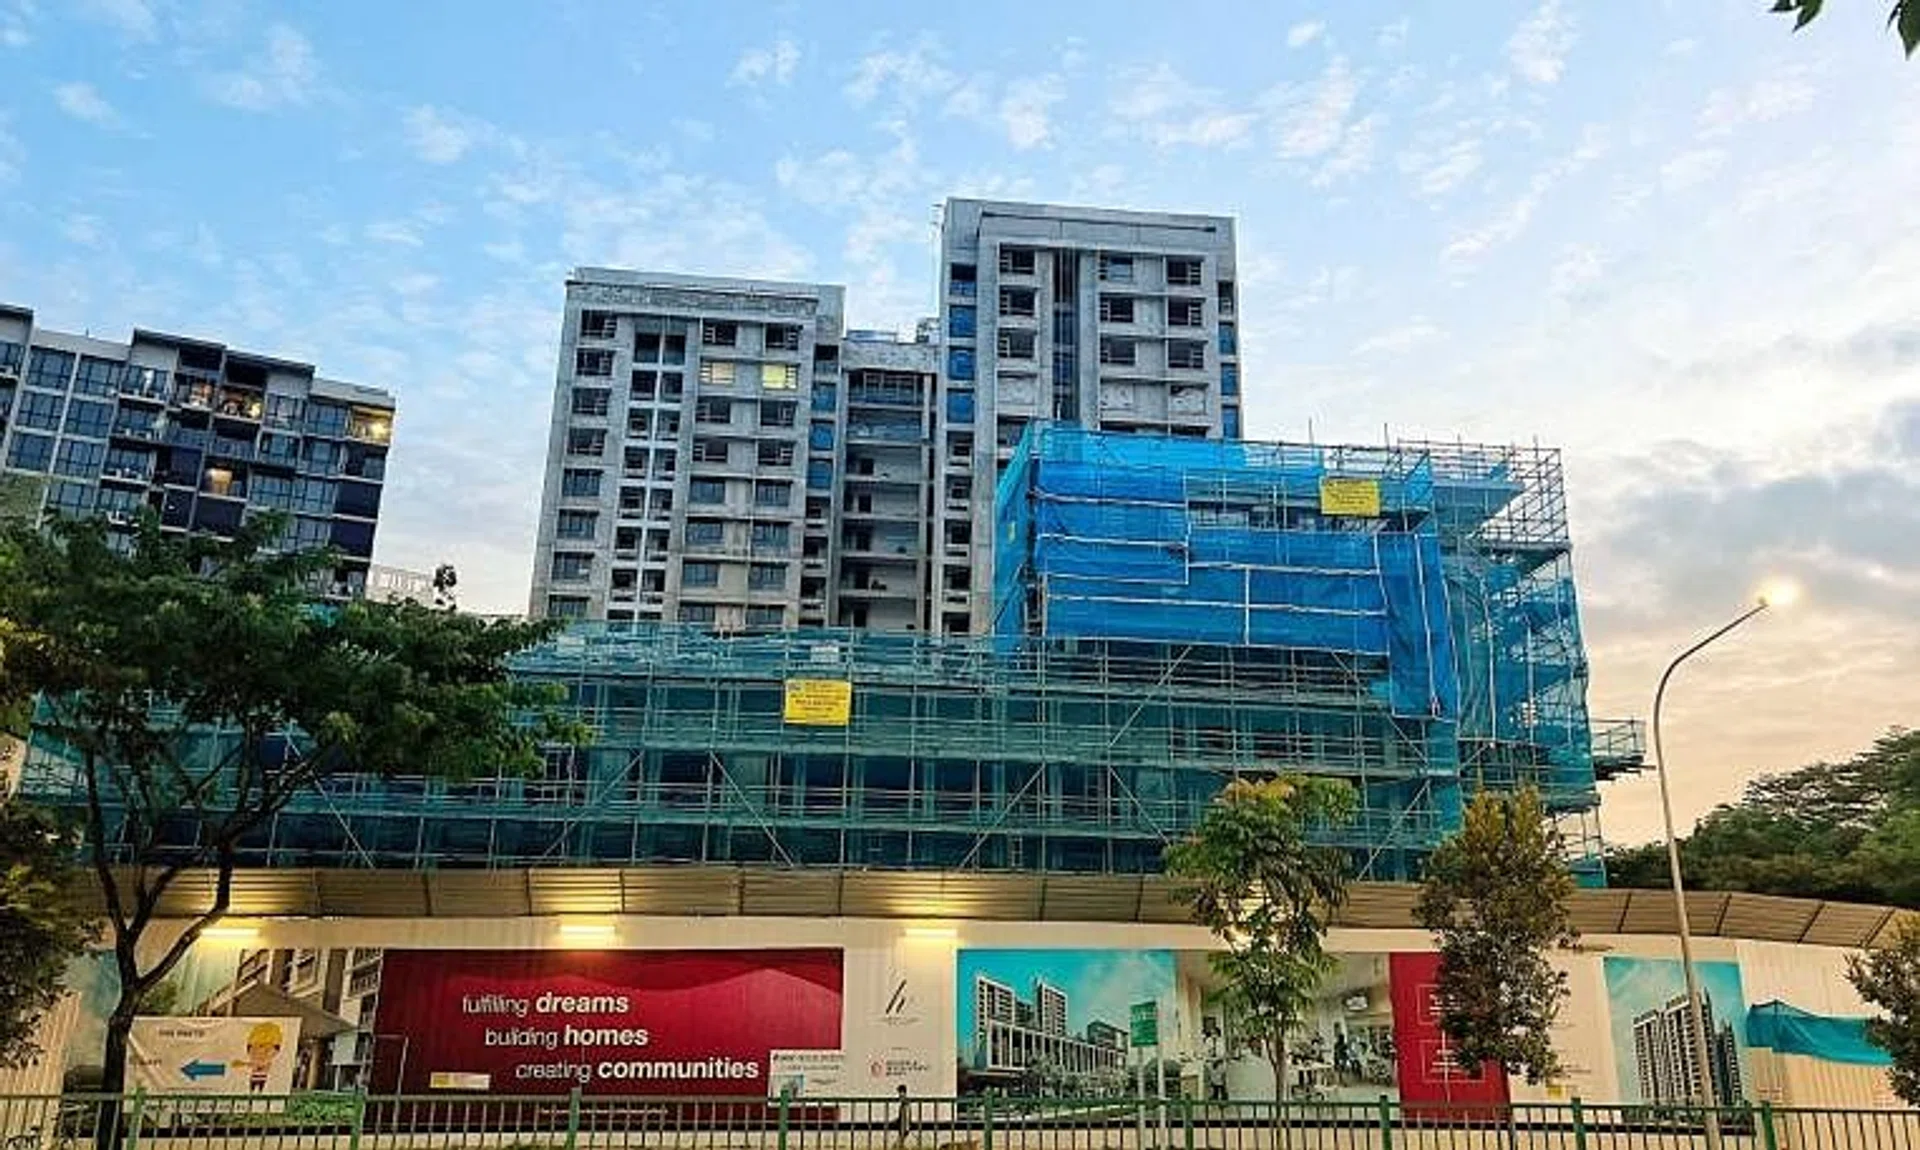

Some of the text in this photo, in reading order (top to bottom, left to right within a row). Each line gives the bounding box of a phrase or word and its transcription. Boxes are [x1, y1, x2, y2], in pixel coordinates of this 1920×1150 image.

[462, 991, 629, 1018] fulfilling dreams
[485, 1024, 649, 1049] building homes
[515, 1058, 592, 1084] creating
[597, 1056, 760, 1079] communities
